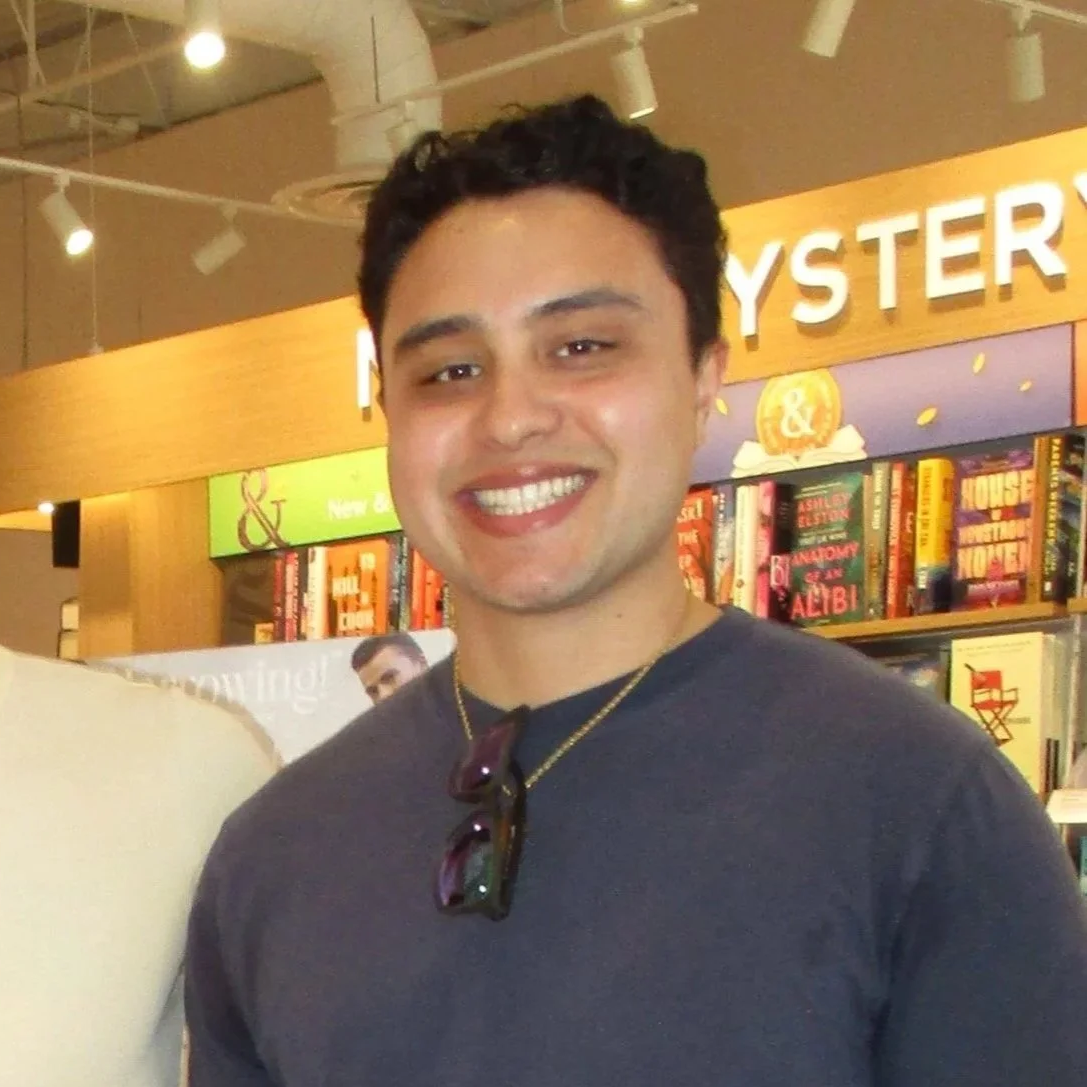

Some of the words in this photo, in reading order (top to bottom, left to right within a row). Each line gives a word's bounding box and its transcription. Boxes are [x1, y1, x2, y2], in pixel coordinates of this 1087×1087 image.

[725, 171, 1087, 337] YSTER
[327, 499, 367, 520] New
[961, 469, 1034, 512] HOUSE
[790, 541, 859, 567] ANATOMY
[790, 583, 858, 620] ALIBI
[189, 650, 328, 715] owing!
